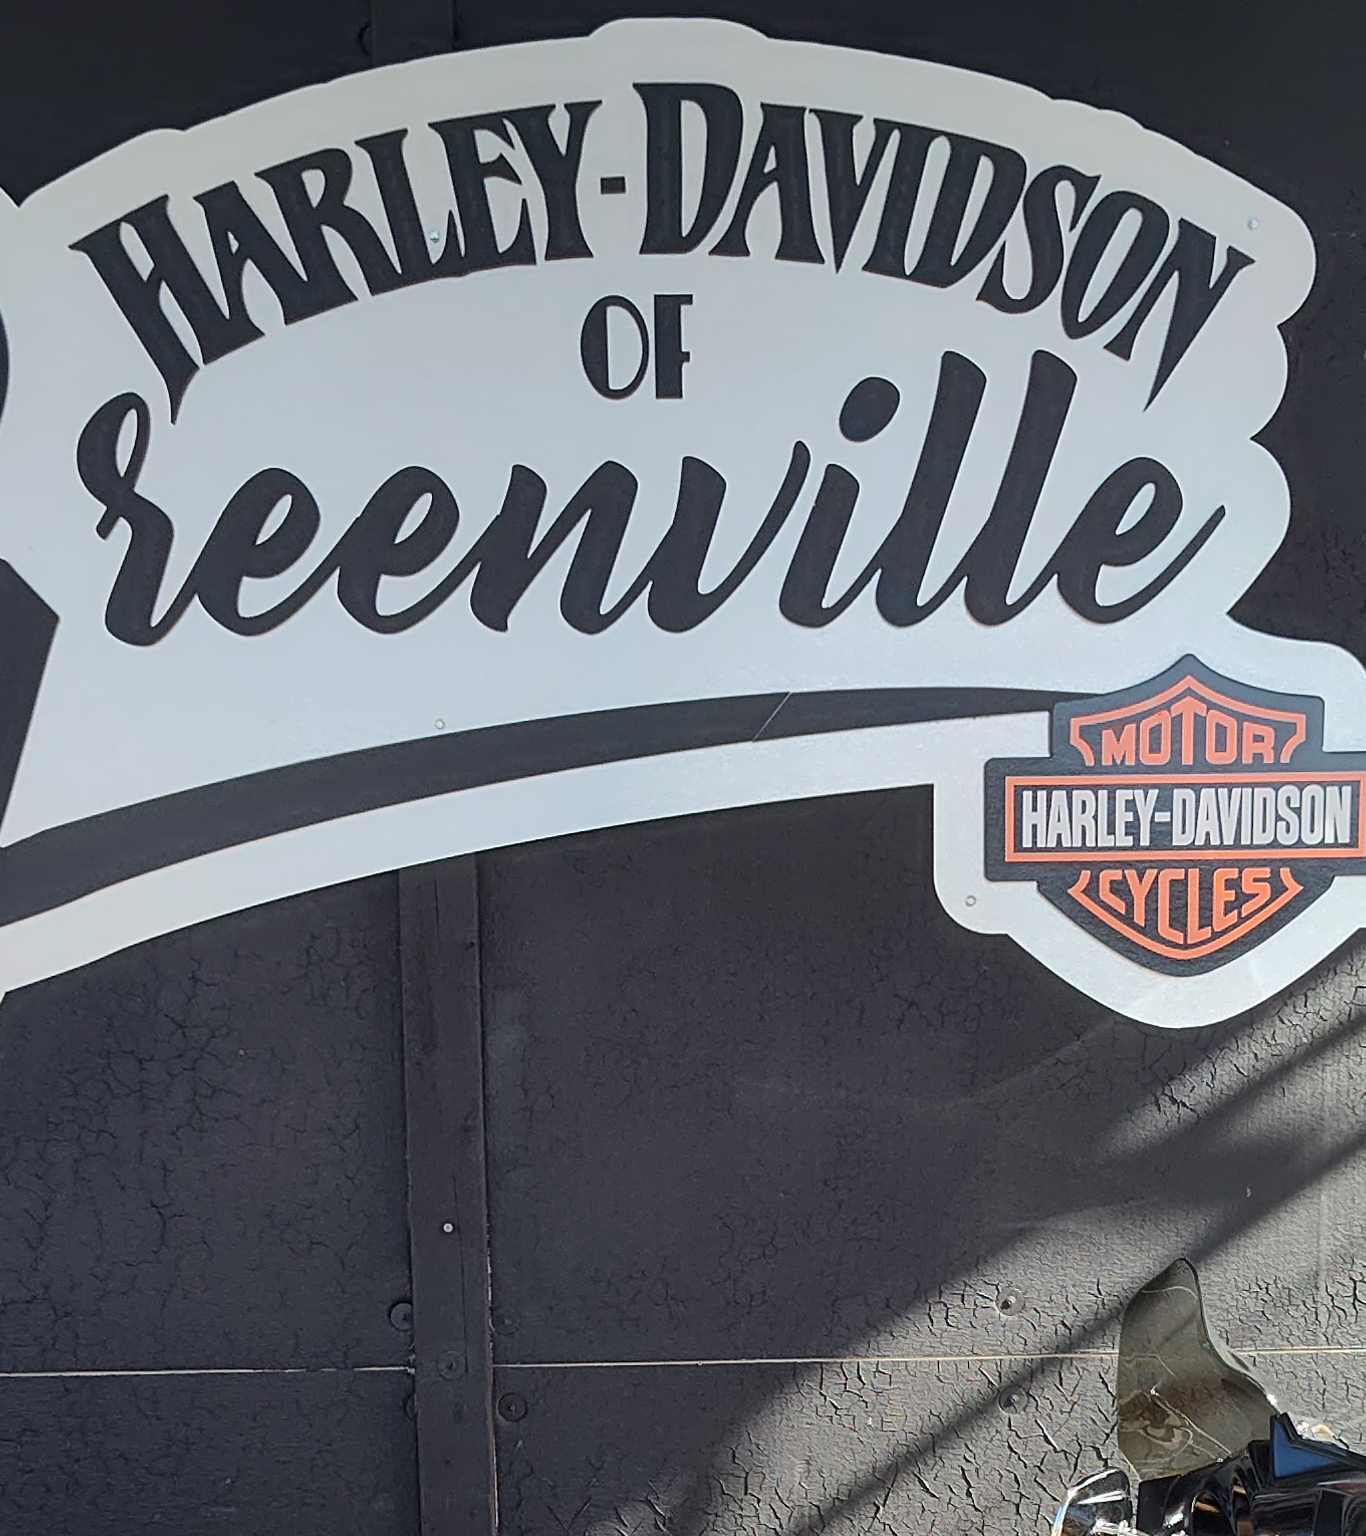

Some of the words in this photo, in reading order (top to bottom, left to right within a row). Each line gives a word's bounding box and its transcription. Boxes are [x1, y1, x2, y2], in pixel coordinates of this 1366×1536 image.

[69, 82, 1256, 425] HARLEY-DAVIDSON
[580, 293, 694, 400] OF
[1101, 695, 1276, 766] MOTOR
[1022, 784, 1352, 849] HARLEY-DAVIDSON
[1099, 867, 1273, 945] CYCLES
